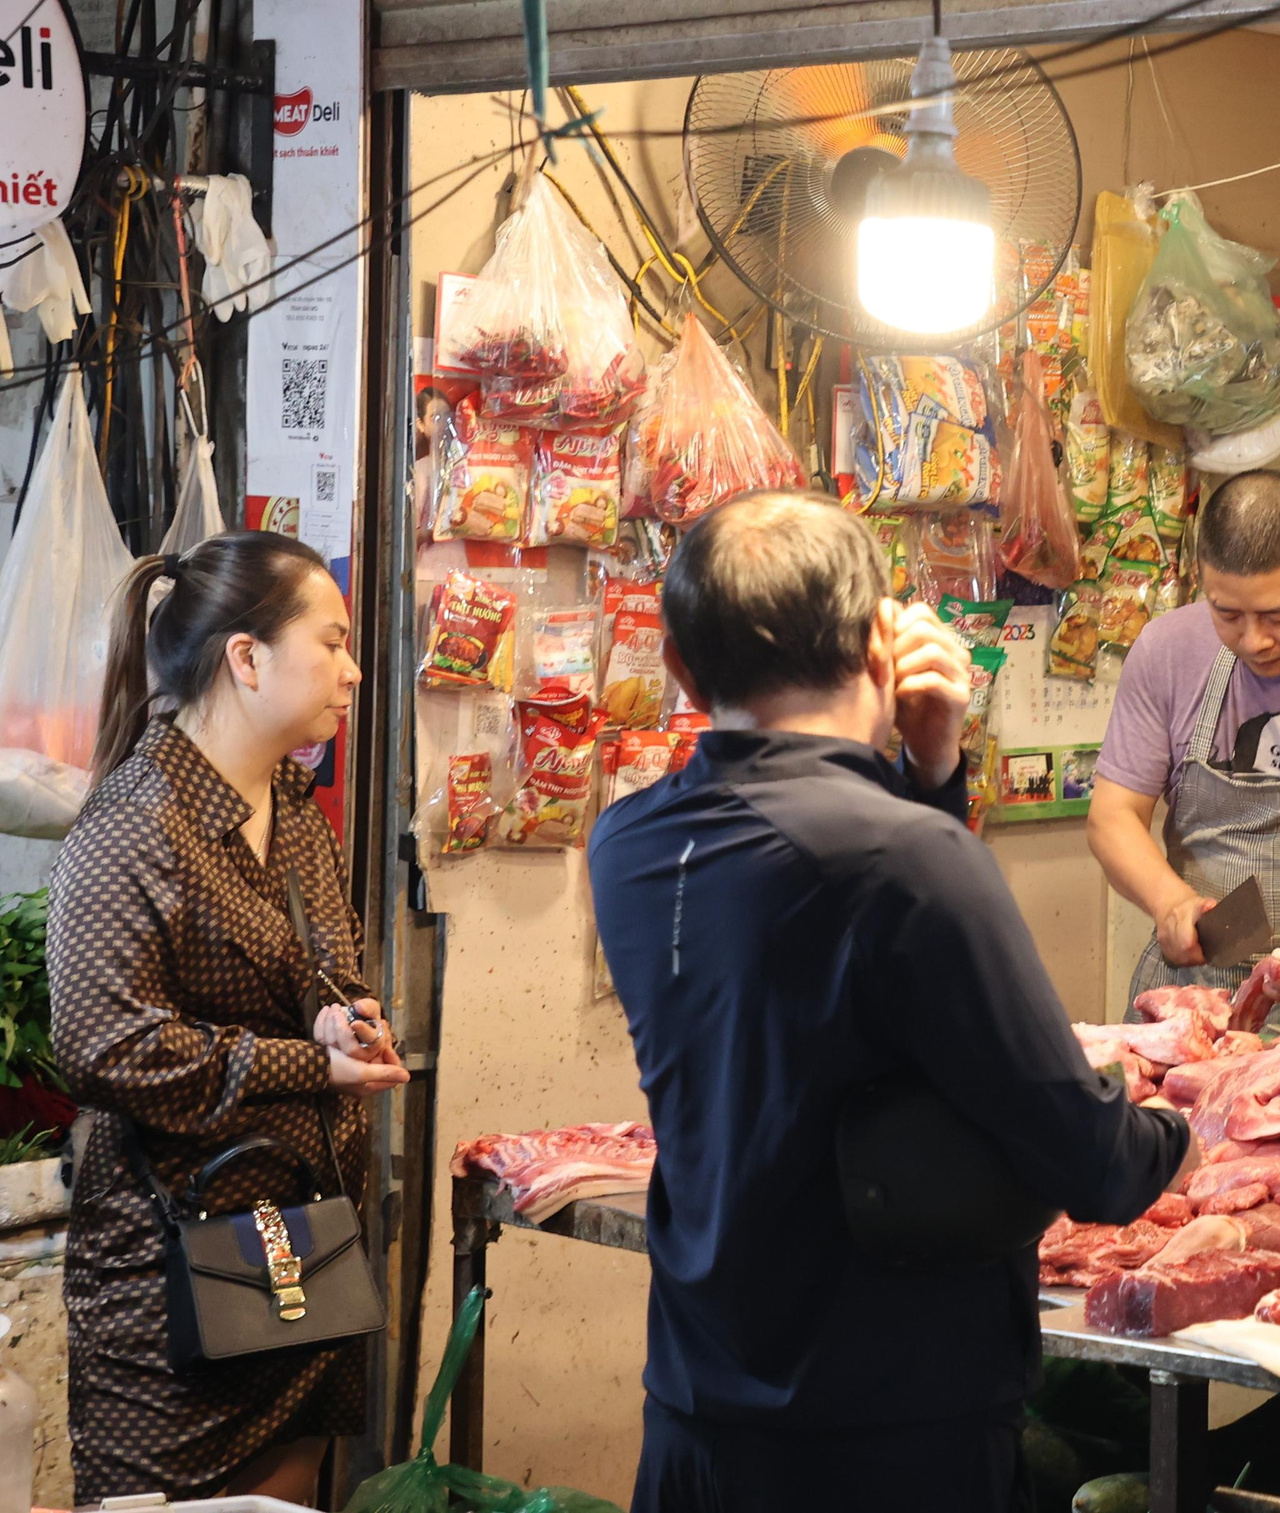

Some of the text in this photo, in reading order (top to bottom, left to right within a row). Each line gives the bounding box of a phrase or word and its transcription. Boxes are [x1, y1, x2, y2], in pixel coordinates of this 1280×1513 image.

[274, 101, 340, 123] MEAT Deli
[1003, 624, 1035, 641] 2023
